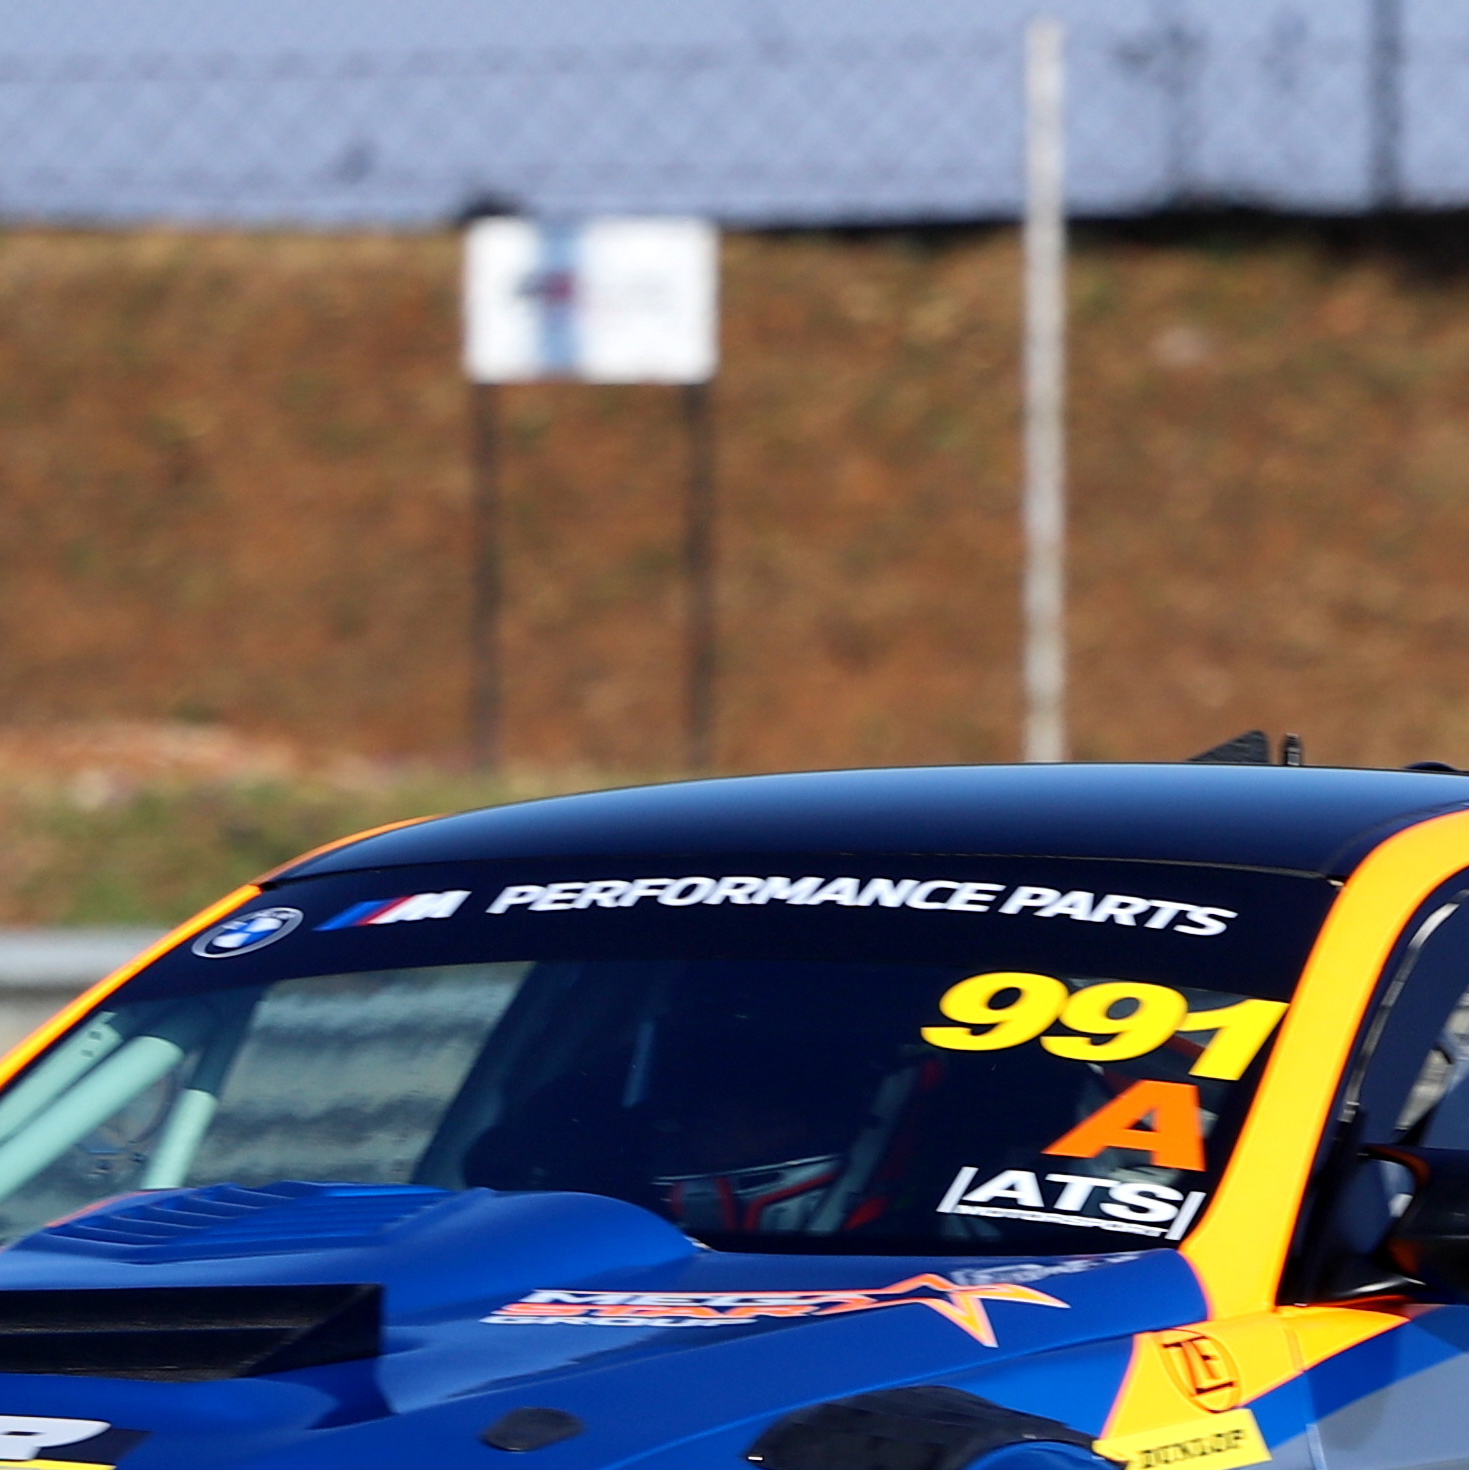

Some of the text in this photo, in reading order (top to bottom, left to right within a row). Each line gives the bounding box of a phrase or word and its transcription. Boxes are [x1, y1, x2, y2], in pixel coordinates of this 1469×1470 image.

[486, 875, 1006, 914] PERFORMANCE
[999, 886, 1239, 936] PARTS
[921, 971, 1290, 1081] 991
[1041, 1078, 1206, 1172] A
[1139, 1428, 1245, 1469] DUNLOP
